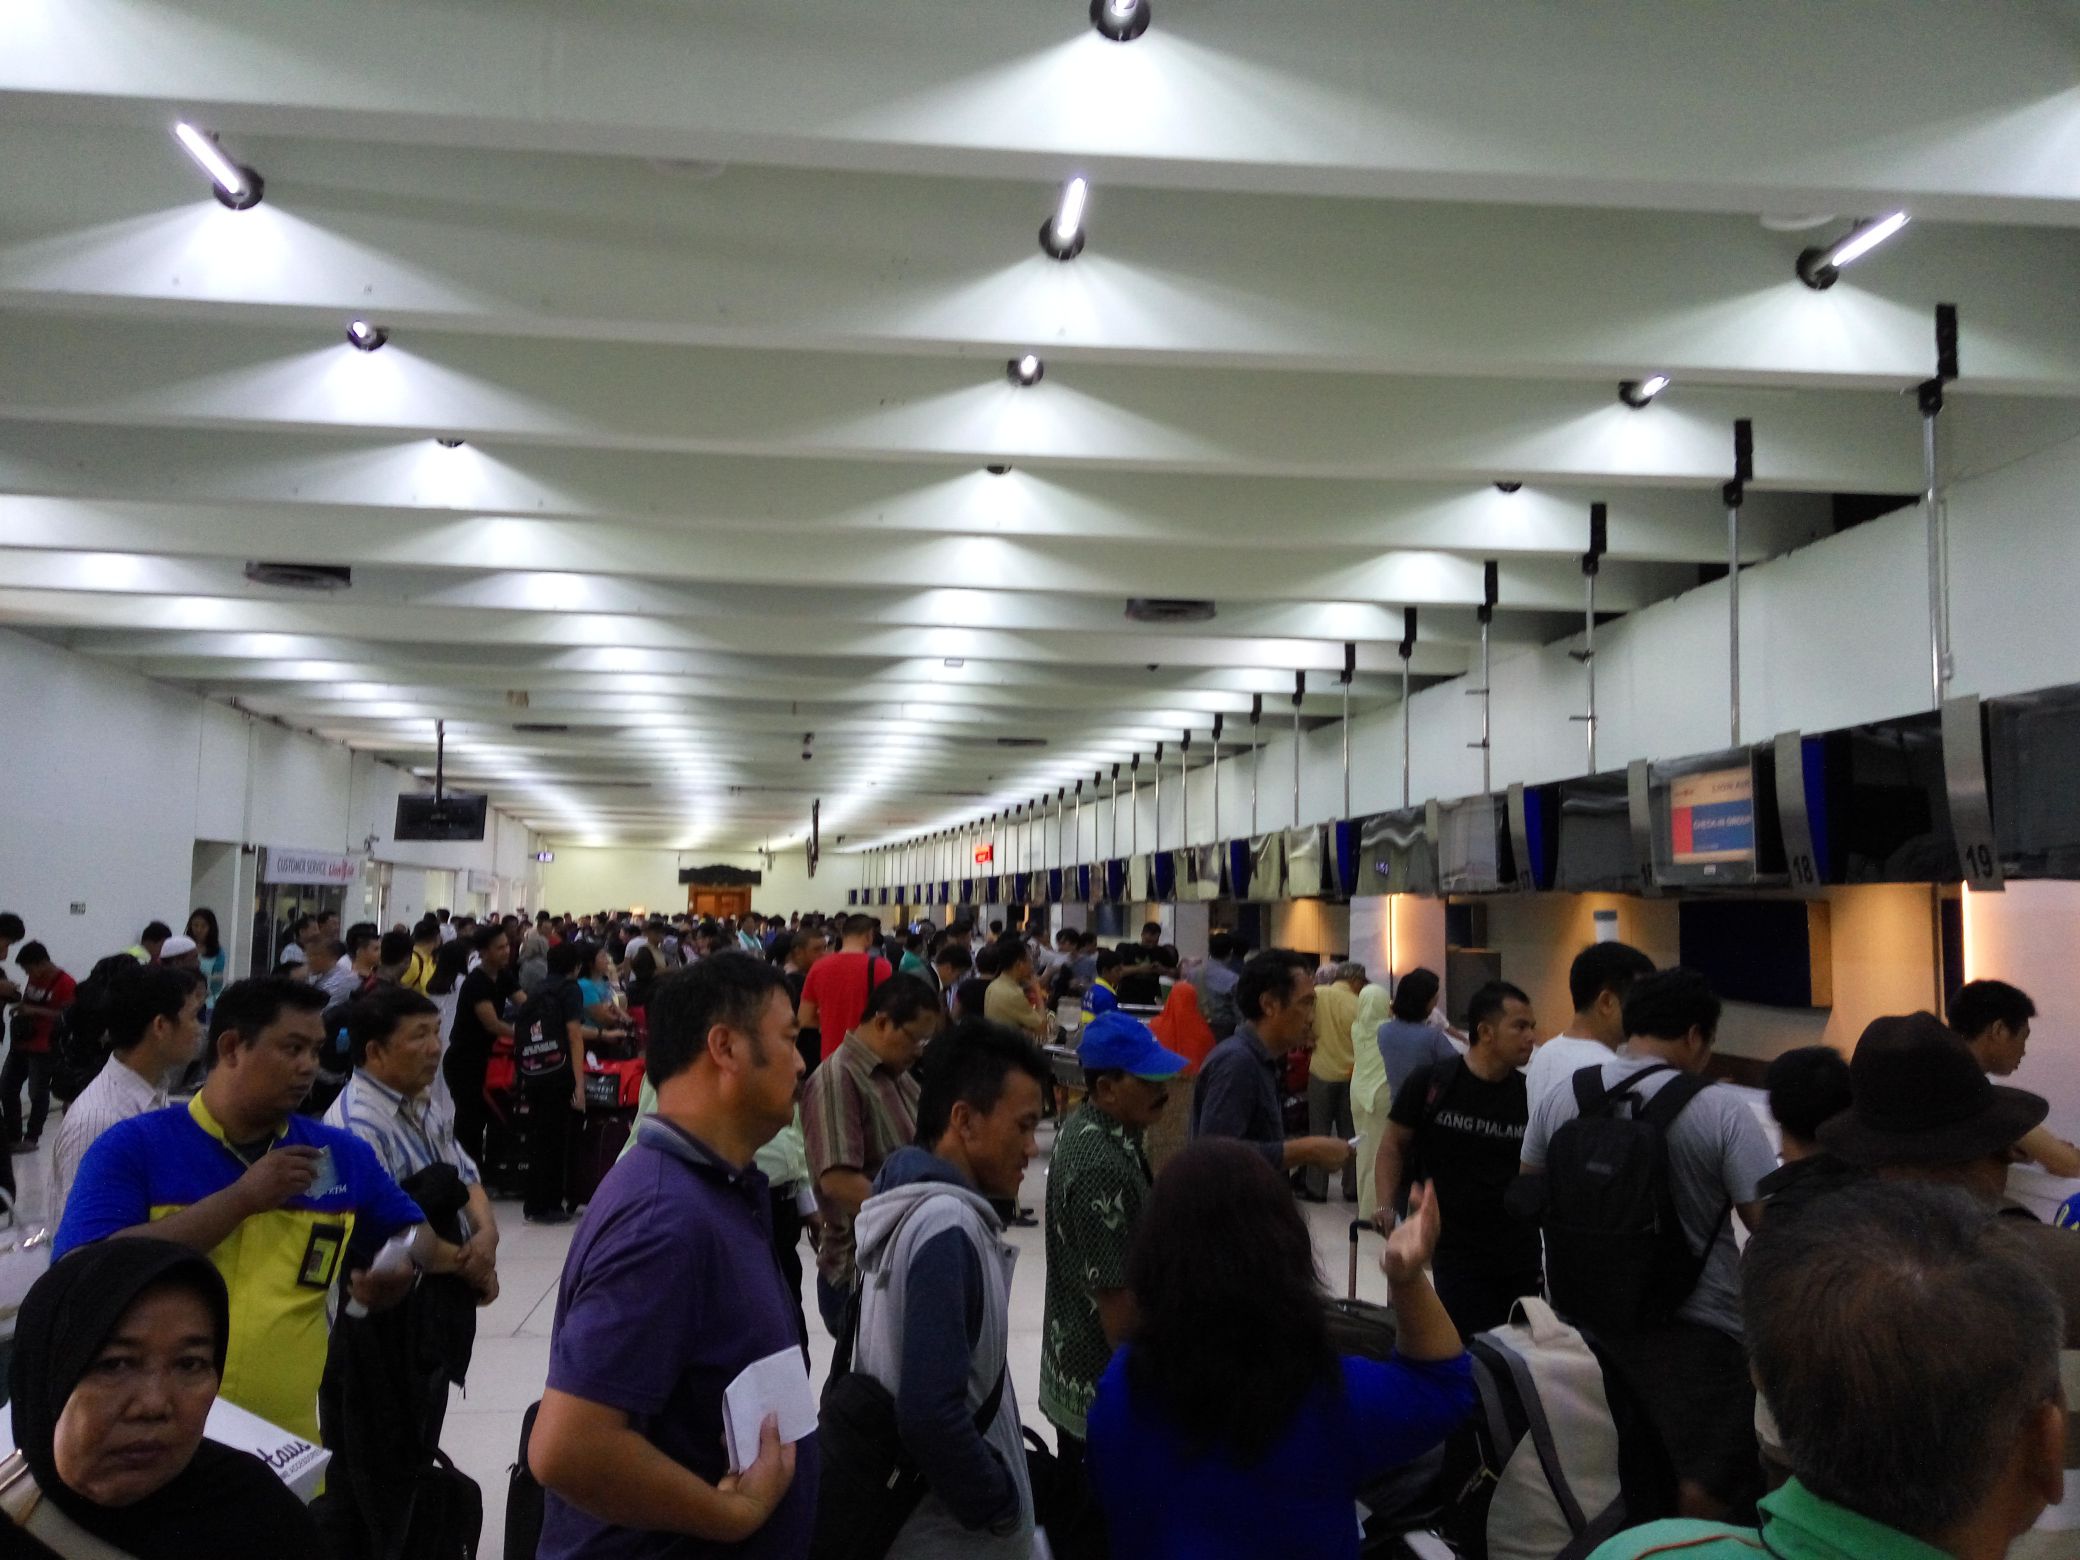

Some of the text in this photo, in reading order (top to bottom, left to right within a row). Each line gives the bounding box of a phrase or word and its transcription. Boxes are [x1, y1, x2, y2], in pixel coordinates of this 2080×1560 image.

[277, 856, 306, 874] CUSTOMER
[306, 858, 327, 876] SERVICE
[1792, 855, 1814, 884] 18
[1966, 844, 1993, 879] 19
